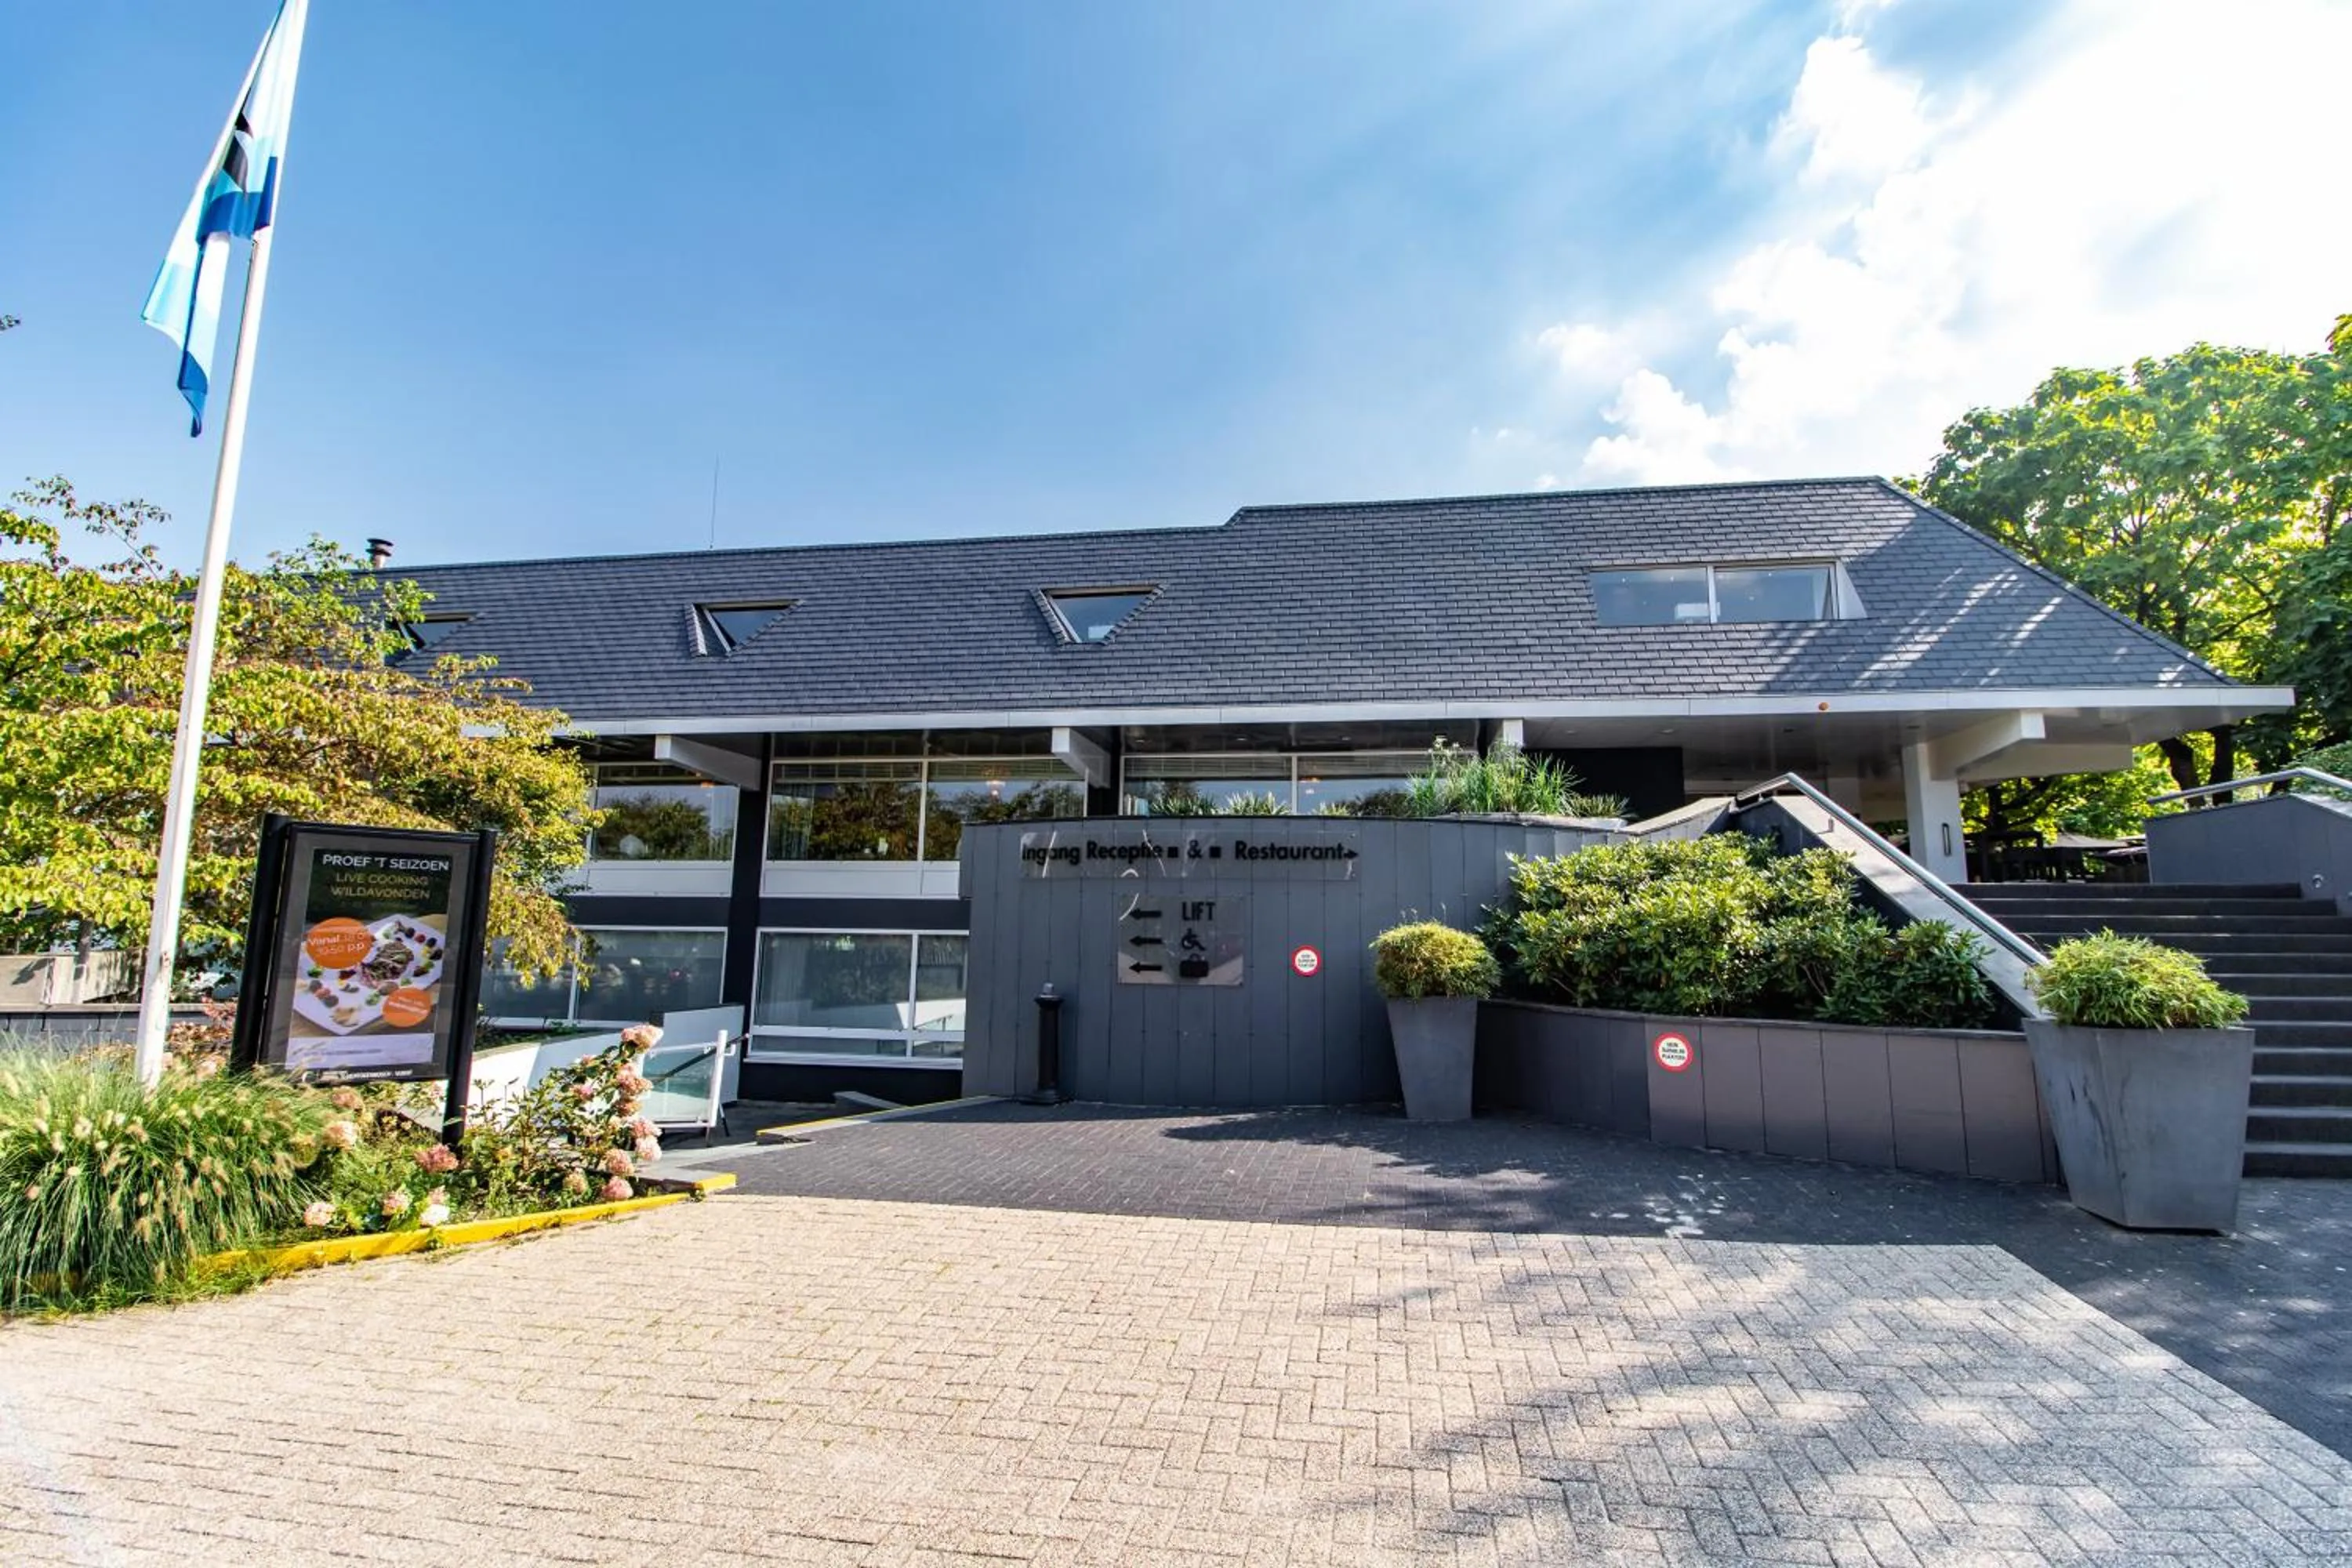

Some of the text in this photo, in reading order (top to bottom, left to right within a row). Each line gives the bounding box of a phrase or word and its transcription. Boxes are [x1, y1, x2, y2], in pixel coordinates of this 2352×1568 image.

[1022, 843, 1081, 865] Ingang
[1086, 840, 1163, 864] Receptie
[1234, 840, 1344, 860] Restaurant
[322, 854, 372, 867] PROEF
[389, 858, 449, 871] SEIZOEN
[336, 873, 429, 886] LIVE COOKING
[330, 886, 430, 899] WILDAVONDEN
[1181, 902, 1215, 921] LIFT
